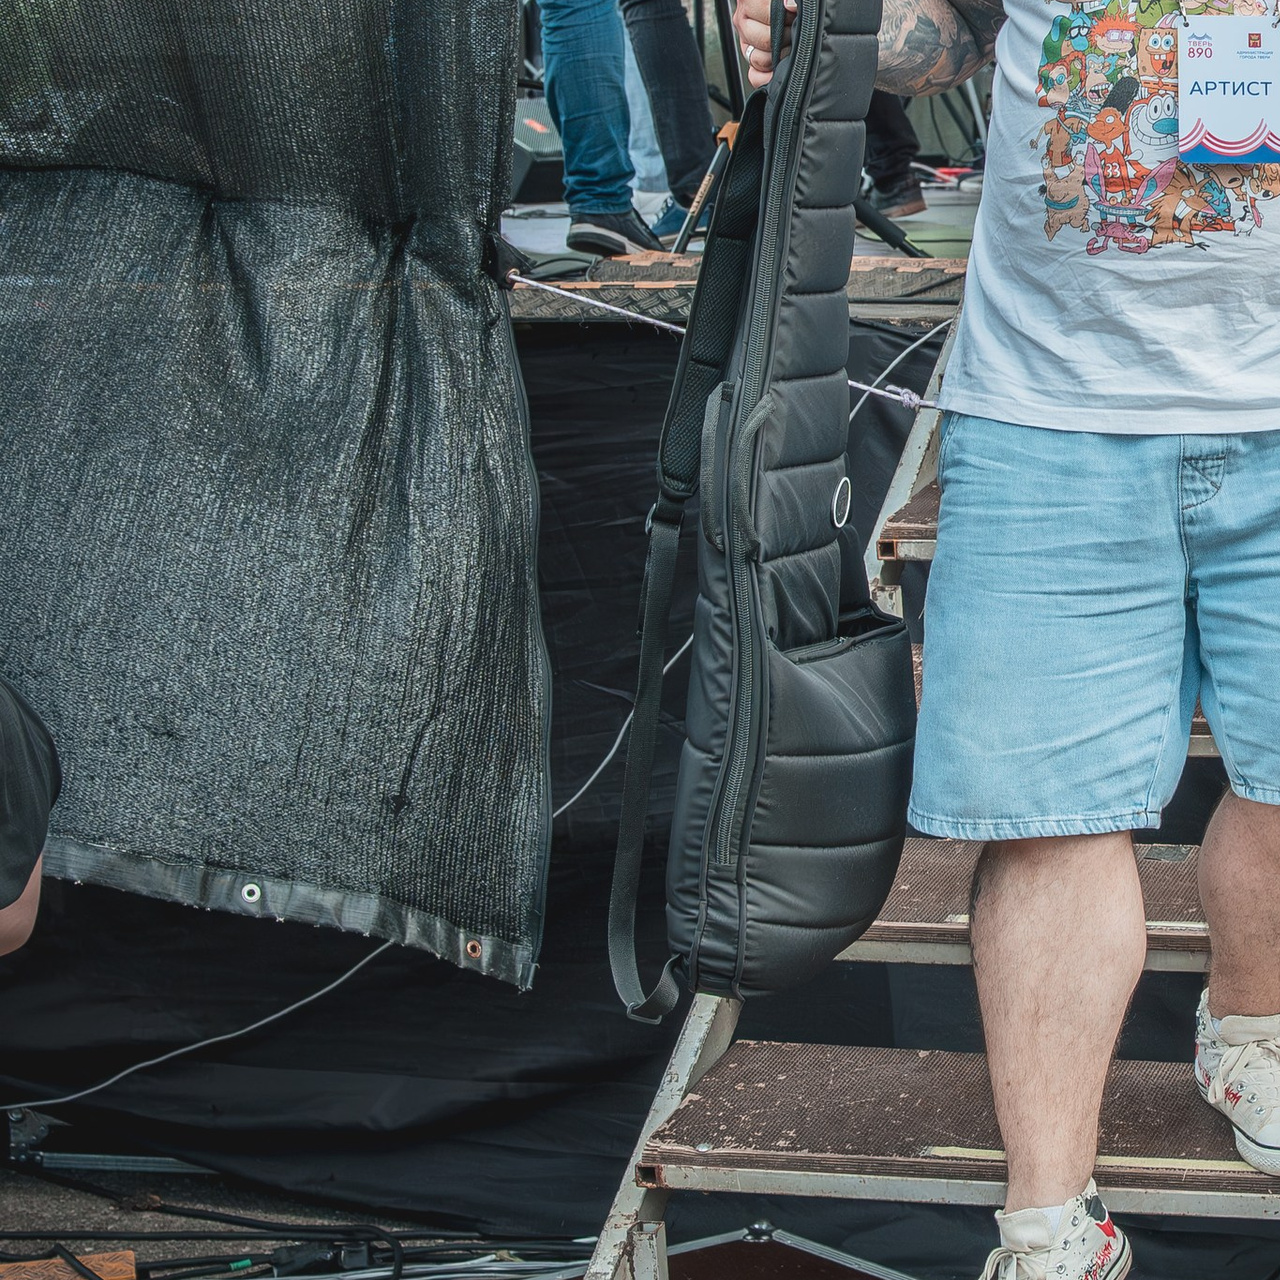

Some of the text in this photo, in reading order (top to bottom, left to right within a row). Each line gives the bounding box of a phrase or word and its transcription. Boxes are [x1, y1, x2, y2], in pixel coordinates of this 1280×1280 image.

[1187, 47, 1213, 59] 890
[1189, 81, 1273, 96] АРТИСТ
[1105, 162, 1121, 178] 33
